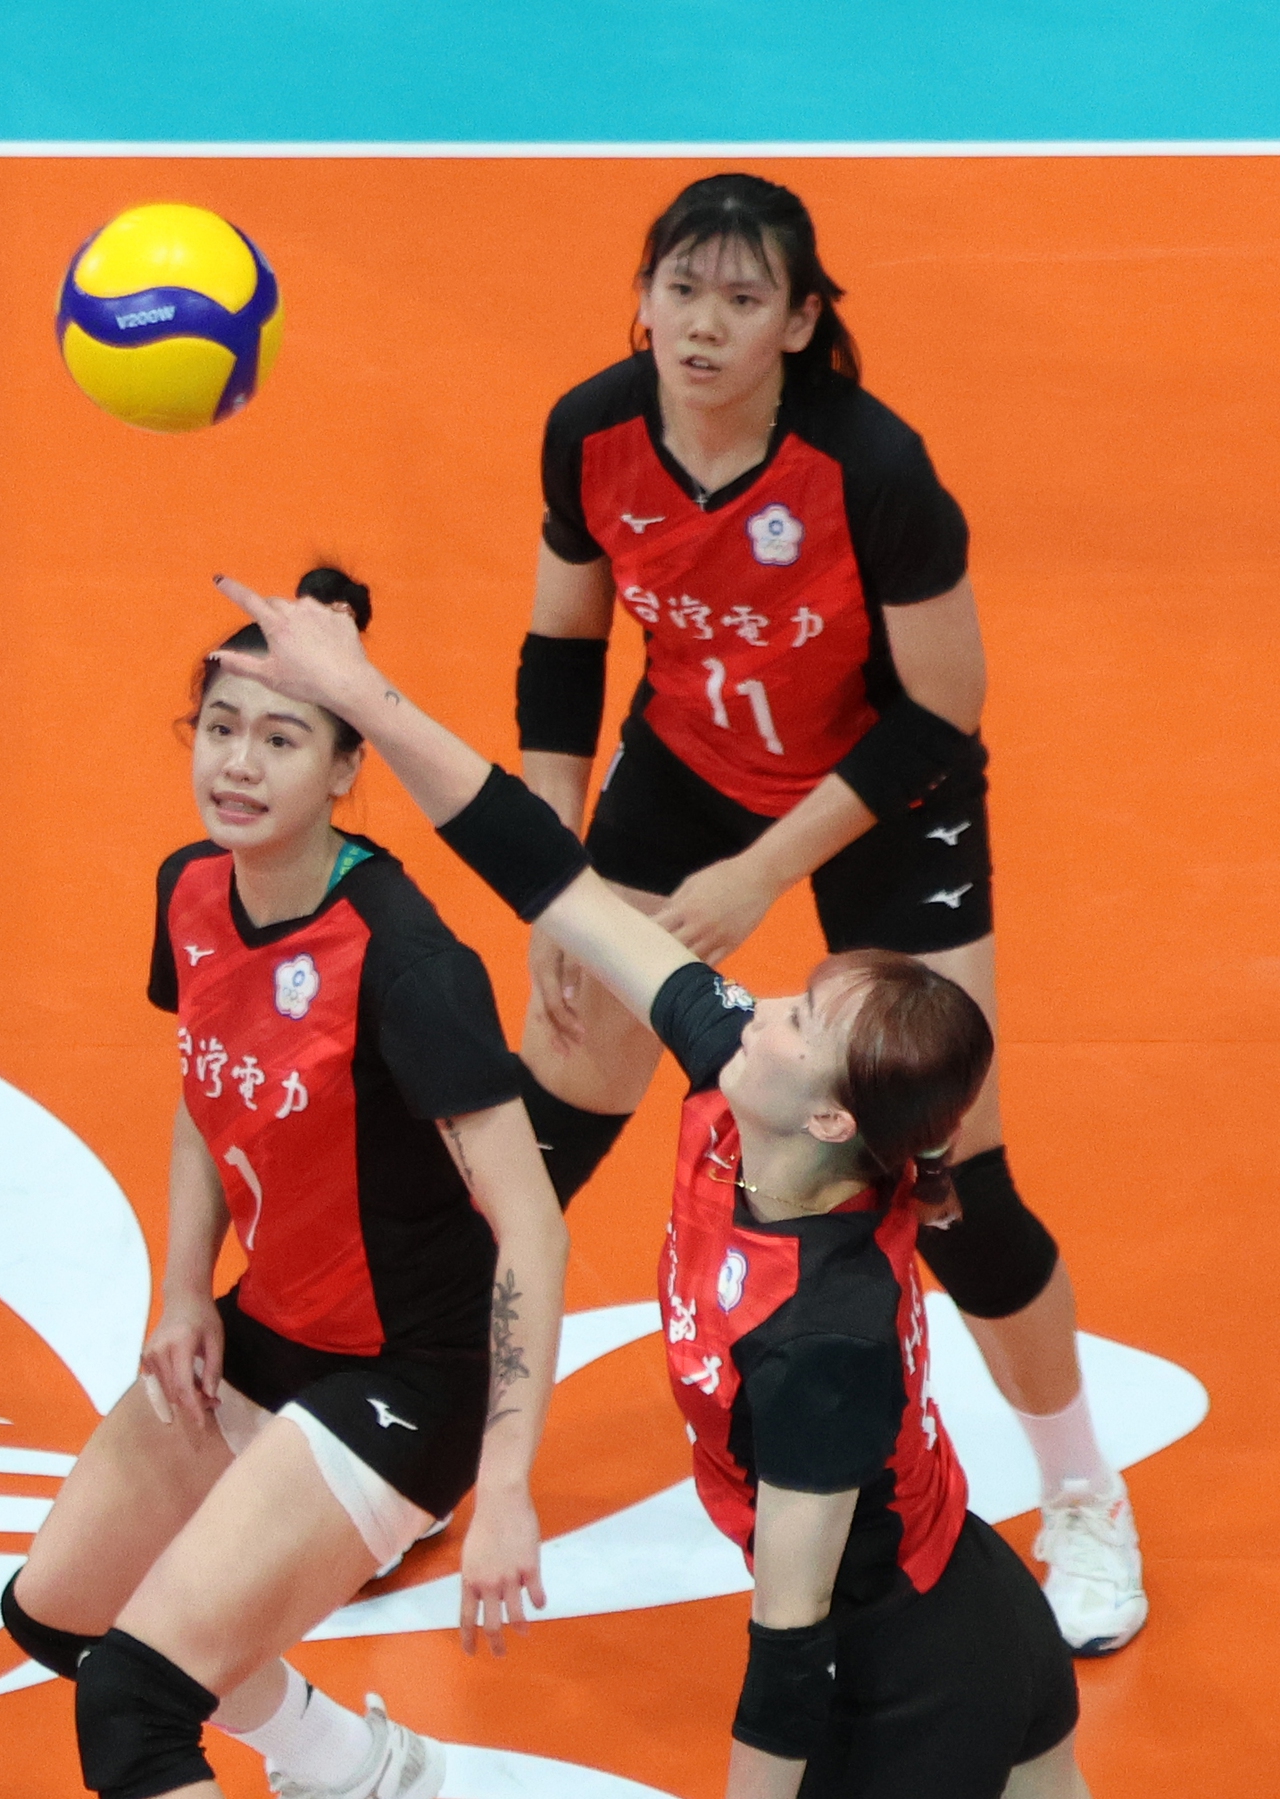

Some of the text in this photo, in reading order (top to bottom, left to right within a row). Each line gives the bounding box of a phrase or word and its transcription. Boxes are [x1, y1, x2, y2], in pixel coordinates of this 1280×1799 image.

[115, 306, 176, 330] V200W
[623, 584, 824, 649] 台灣電力
[701, 656, 785, 756] 11
[223, 1144, 263, 1251] 1
